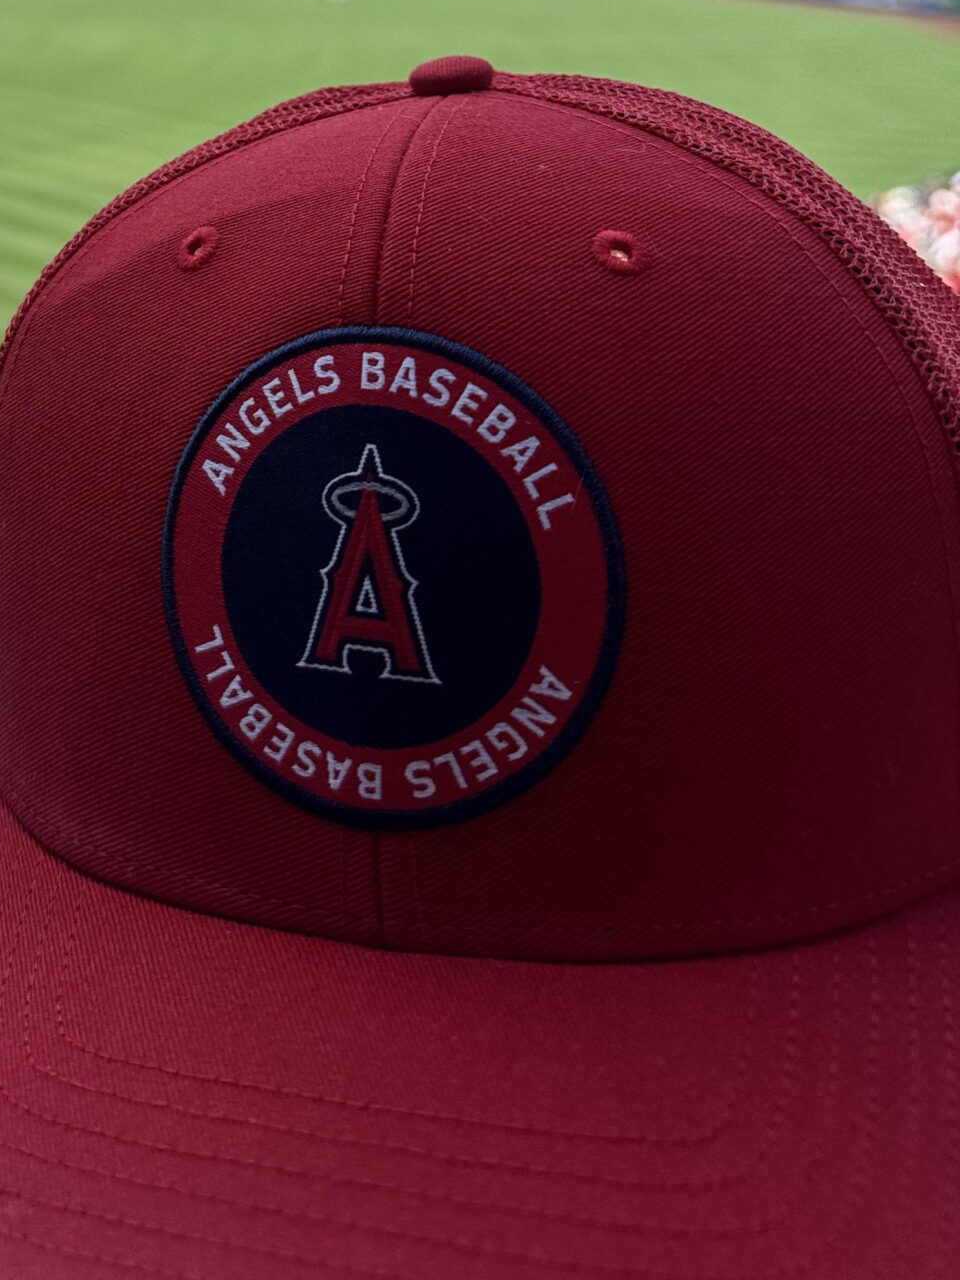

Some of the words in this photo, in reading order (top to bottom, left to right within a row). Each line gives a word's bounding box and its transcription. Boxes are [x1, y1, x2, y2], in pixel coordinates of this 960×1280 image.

[200, 355, 341, 495] ANGELS
[360, 351, 575, 530] BASEBALL
[296, 443, 442, 684] A
[195, 624, 382, 800] BASEBALL
[404, 665, 573, 799] ANGELS
